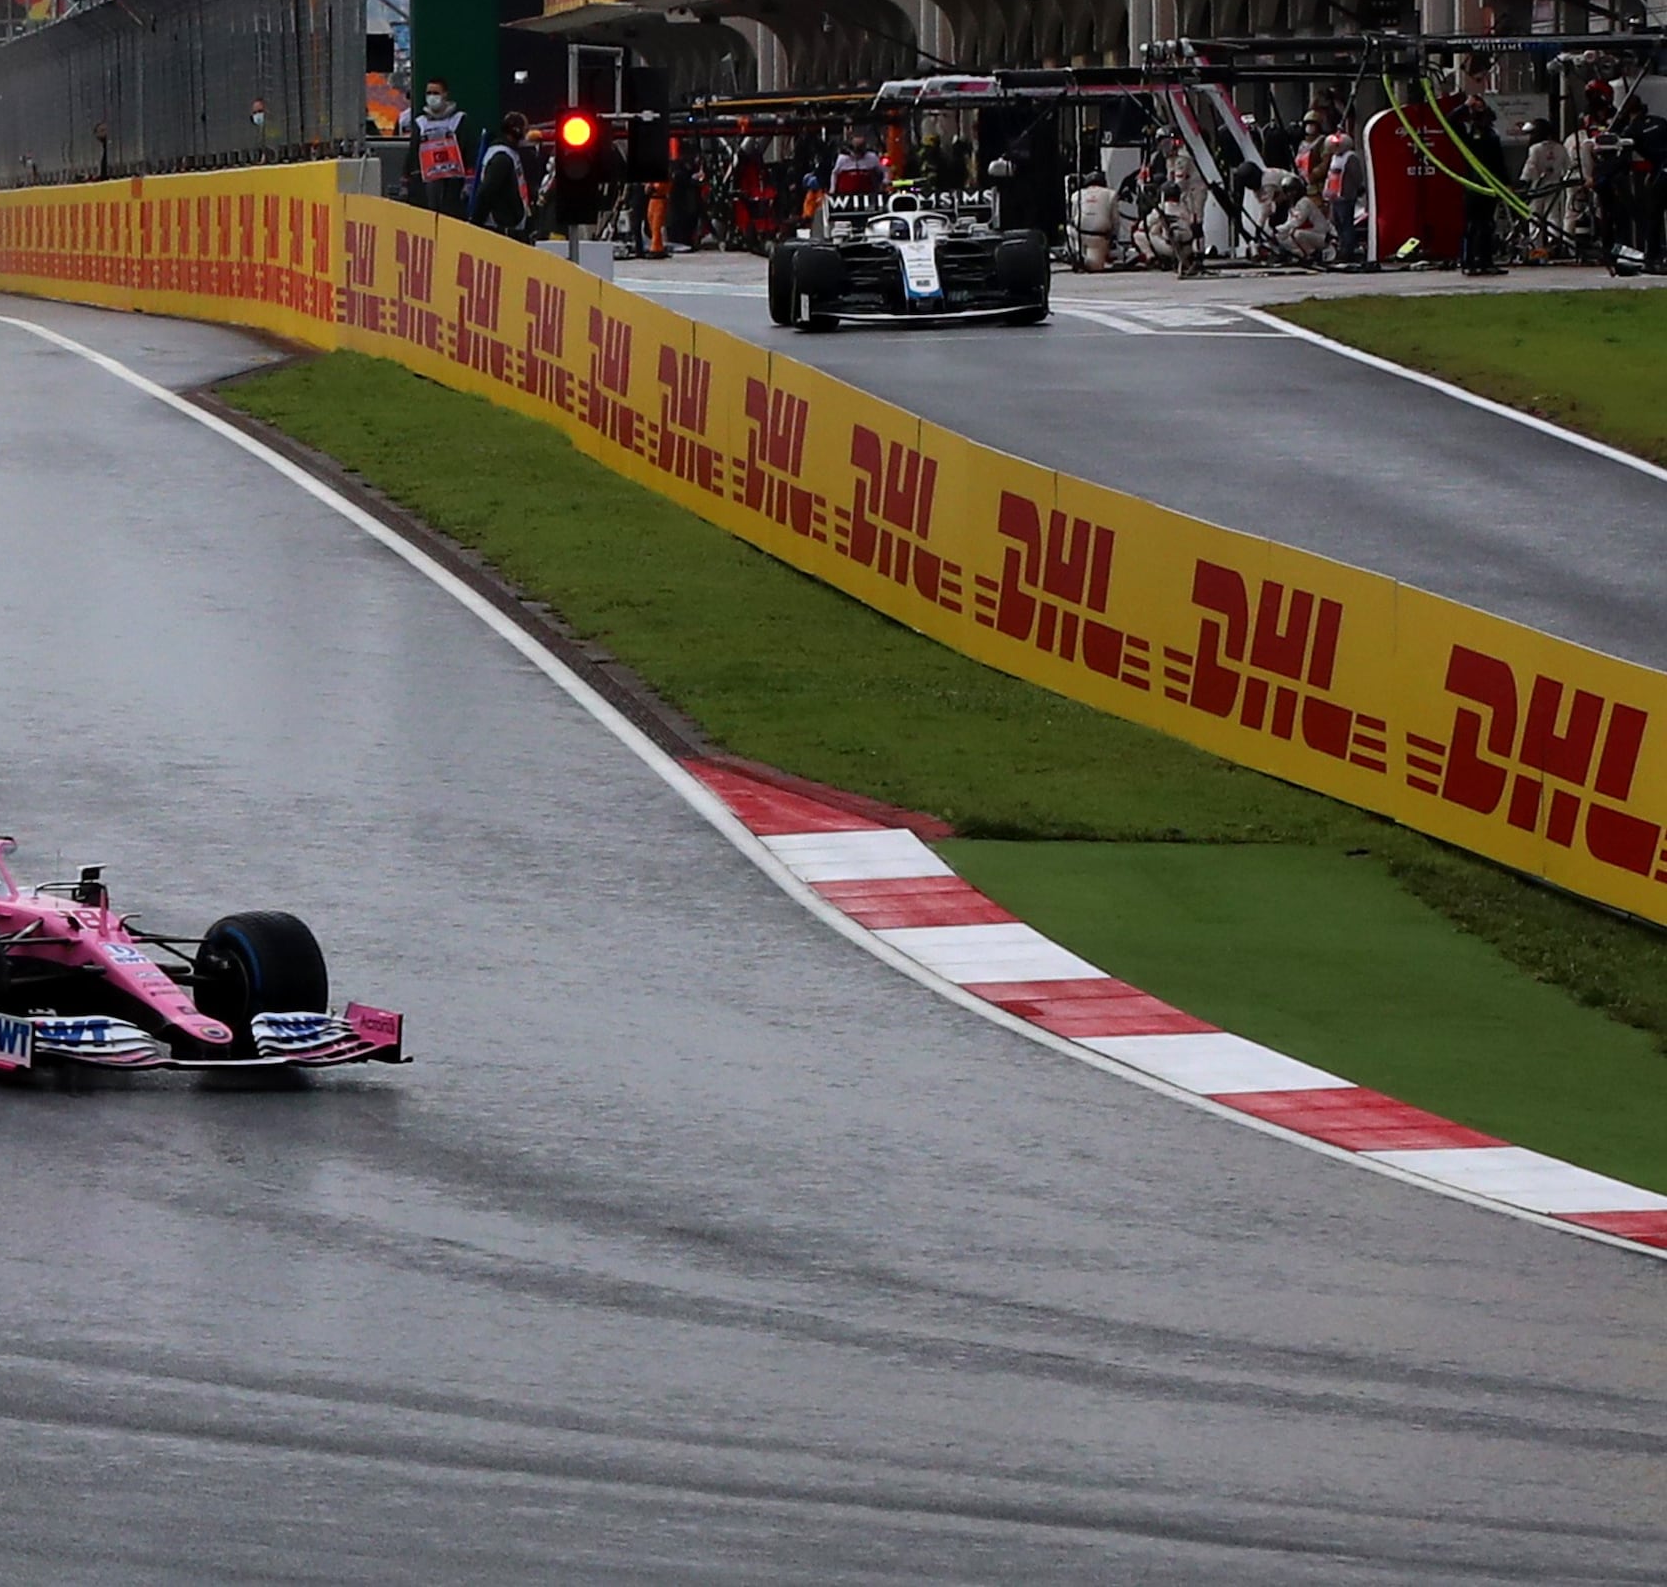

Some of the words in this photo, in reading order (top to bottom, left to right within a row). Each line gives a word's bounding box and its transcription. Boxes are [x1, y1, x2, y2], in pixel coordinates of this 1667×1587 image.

[344, 220, 382, 333] DHL
[395, 229, 441, 350] DHL
[455, 251, 506, 381] DHL
[525, 276, 571, 412] DHL
[587, 305, 635, 450] DHL
[657, 343, 717, 491] DHL
[743, 377, 815, 538] DHL
[850, 424, 944, 601] DHL
[994, 490, 1125, 678] DHL
[1190, 559, 1355, 760] DHL
[1443, 644, 1662, 877] DHL
